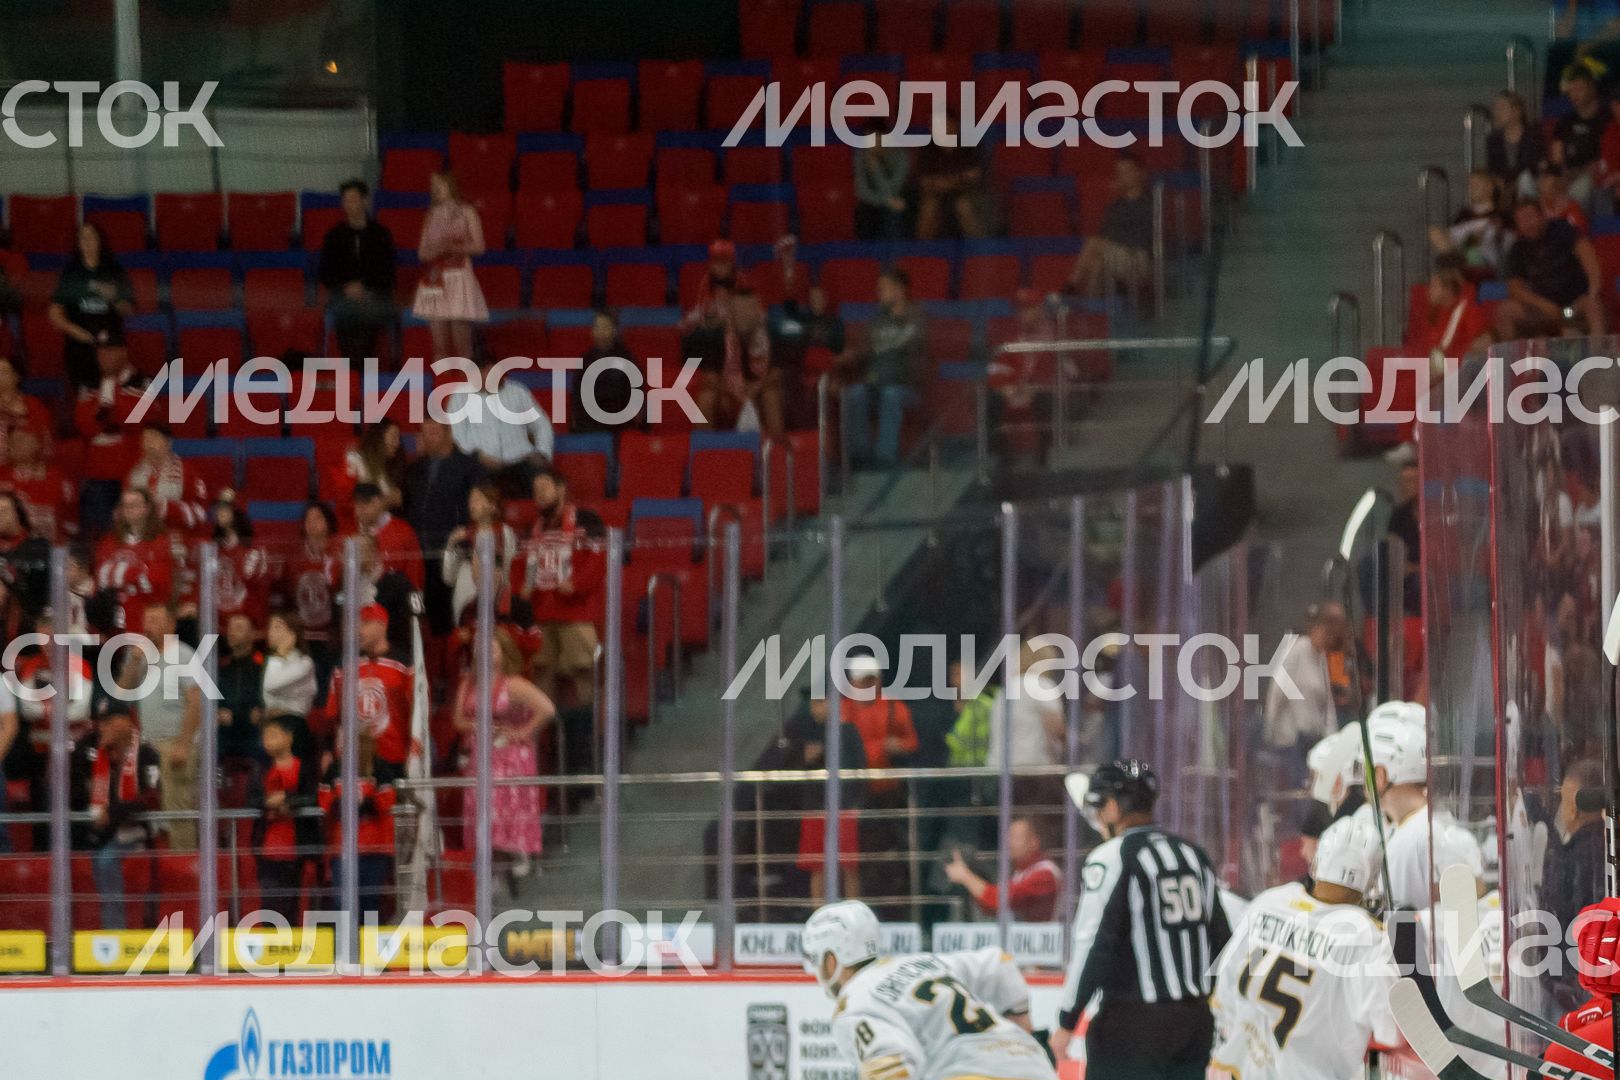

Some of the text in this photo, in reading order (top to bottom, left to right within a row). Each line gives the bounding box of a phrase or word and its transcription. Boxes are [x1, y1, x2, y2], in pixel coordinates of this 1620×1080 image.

[1160, 872, 1202, 925] 50
[740, 932, 801, 952] KHL.R
[1250, 911, 1336, 961] PETUKHOV
[1238, 945, 1316, 1050] 15
[268, 1040, 391, 1075] ГАЗПРОМ
